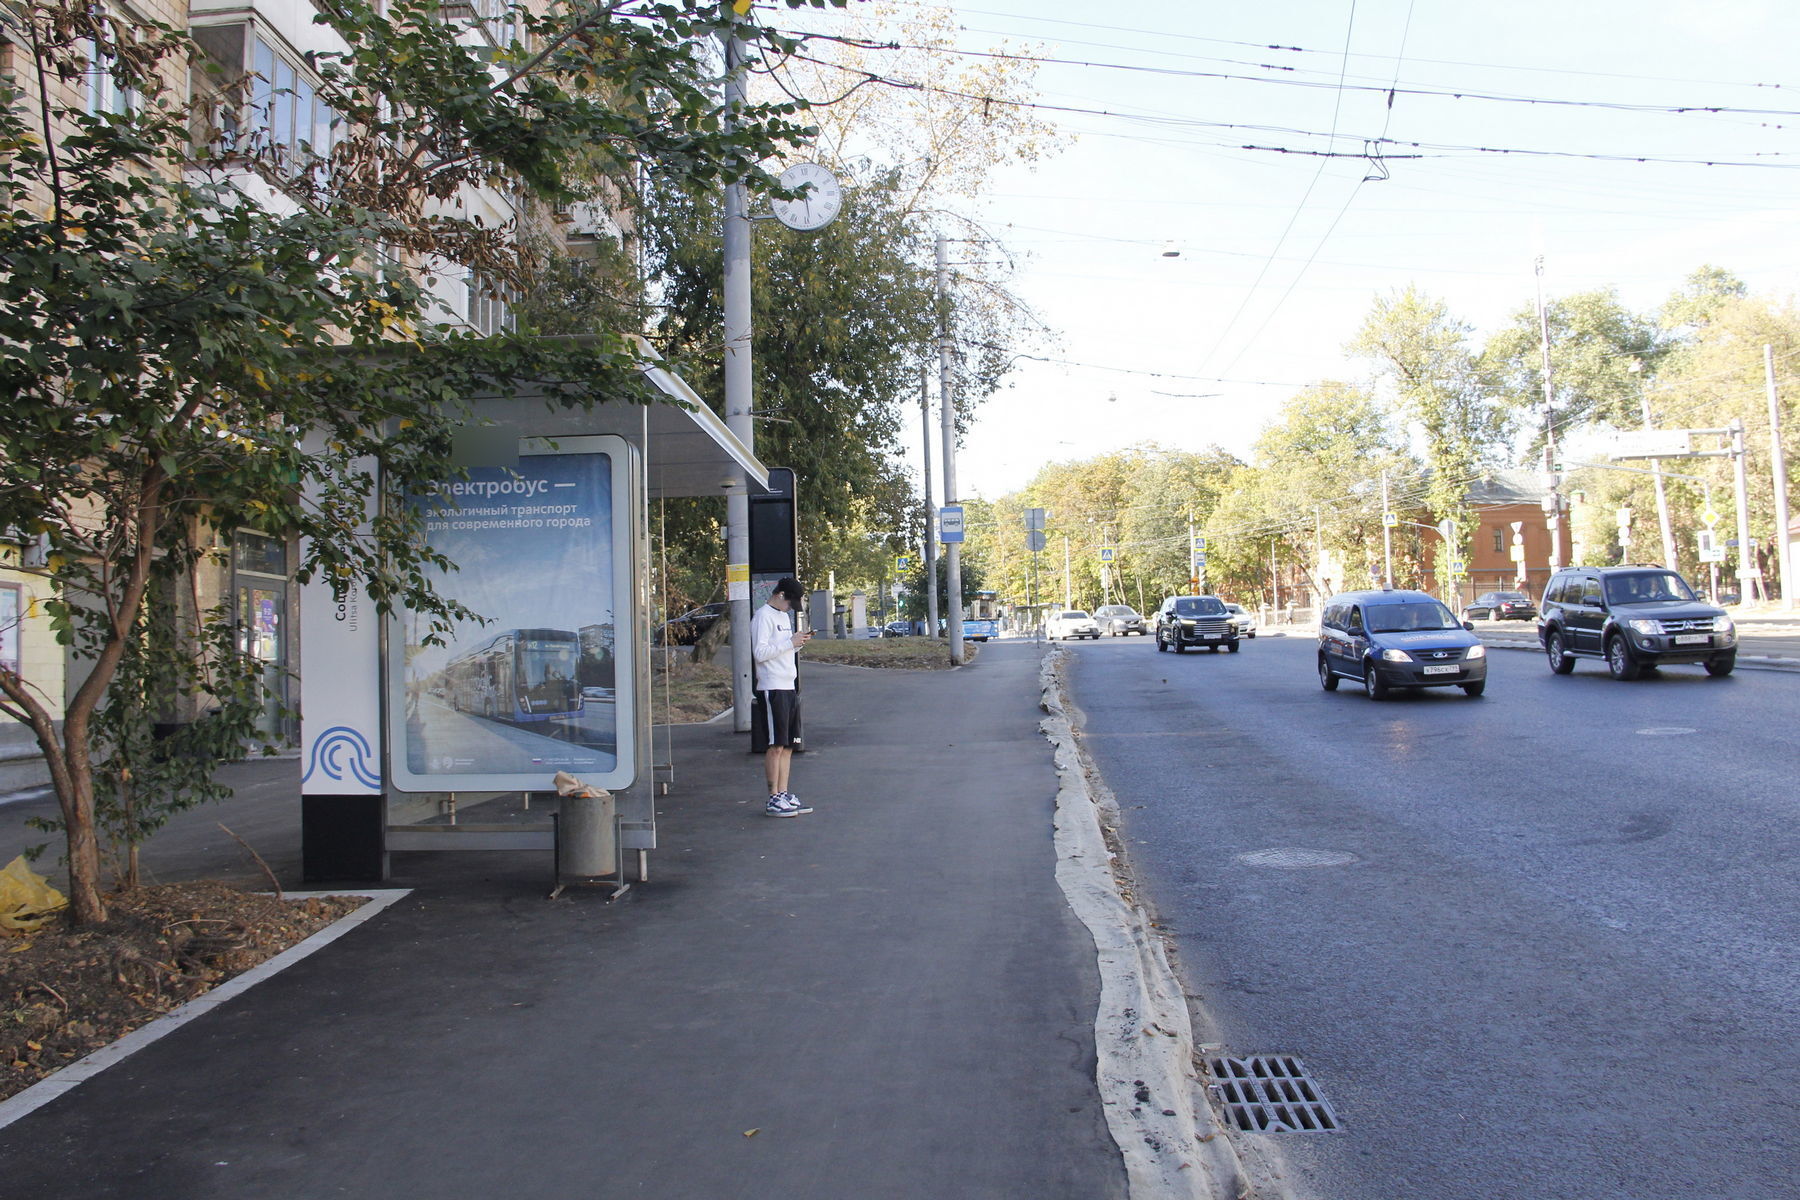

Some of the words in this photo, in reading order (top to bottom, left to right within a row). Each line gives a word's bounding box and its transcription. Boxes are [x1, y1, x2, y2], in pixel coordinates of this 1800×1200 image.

[511, 504, 578, 518] транспорт
[427, 520, 449, 532] для
[451, 518, 543, 532] современного
[546, 516, 591, 530] города
[349, 605, 358, 632] Ulitsa
